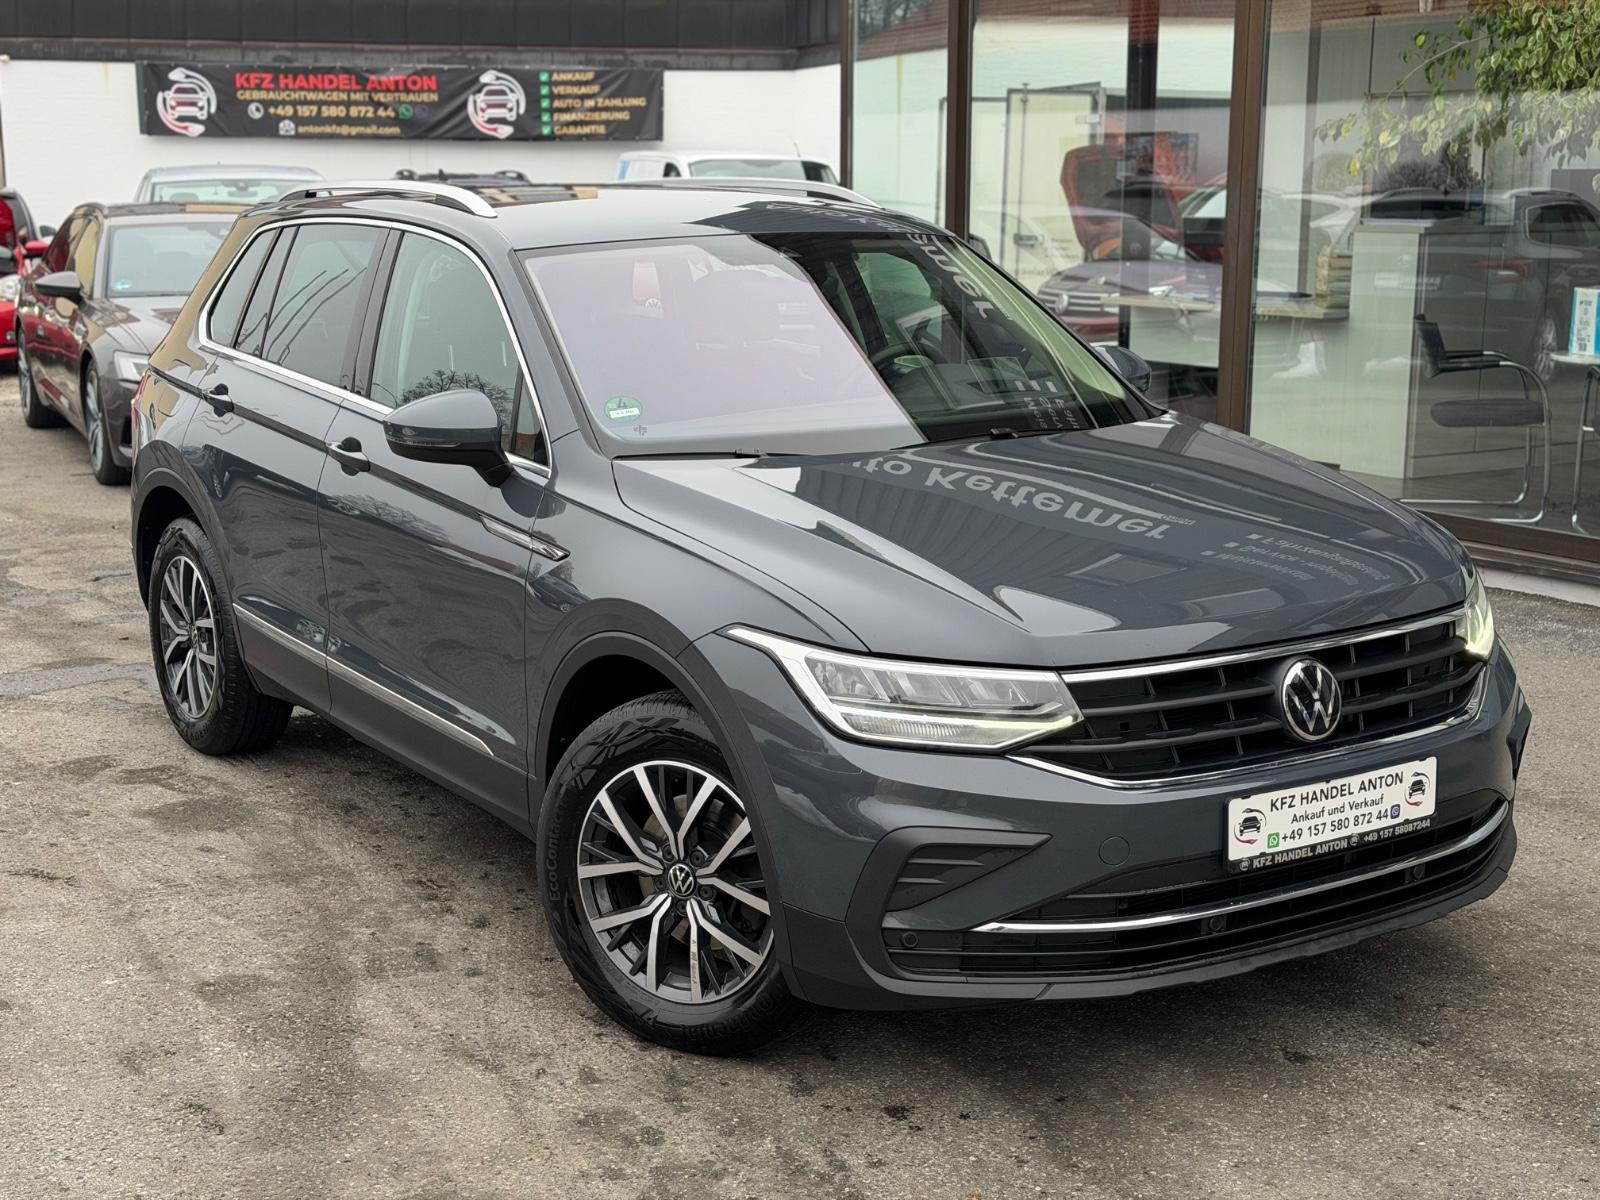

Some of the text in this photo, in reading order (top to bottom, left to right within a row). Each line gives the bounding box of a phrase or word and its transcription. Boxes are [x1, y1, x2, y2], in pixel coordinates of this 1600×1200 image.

[235, 73, 438, 91] KFZ HANDEL ANTON
[552, 72, 595, 81] ANKAUF
[552, 84, 600, 95] VERKAUF
[236, 90, 439, 102] GEBRAUCHTWAGEN MIT VERTRAUEN
[552, 97, 647, 108] AUTO IN ZAHLUNG
[268, 105, 396, 118] +49 157 580 872 44
[553, 111, 630, 121] FINANZIERUNG
[553, 125, 606, 135] GARANTIE
[1270, 771, 1403, 812] KFZ HANDEL ANTON
[1291, 794, 1385, 825] Ankauf und Verkauf
[1281, 808, 1389, 843] +49 157 580 872 44
[1253, 853, 1272, 869] KFZ
[1274, 845, 1314, 864] HANDEL
[1315, 838, 1348, 856] ANTON
[1363, 831, 1377, 843] +49
[1378, 827, 1393, 840] 157
